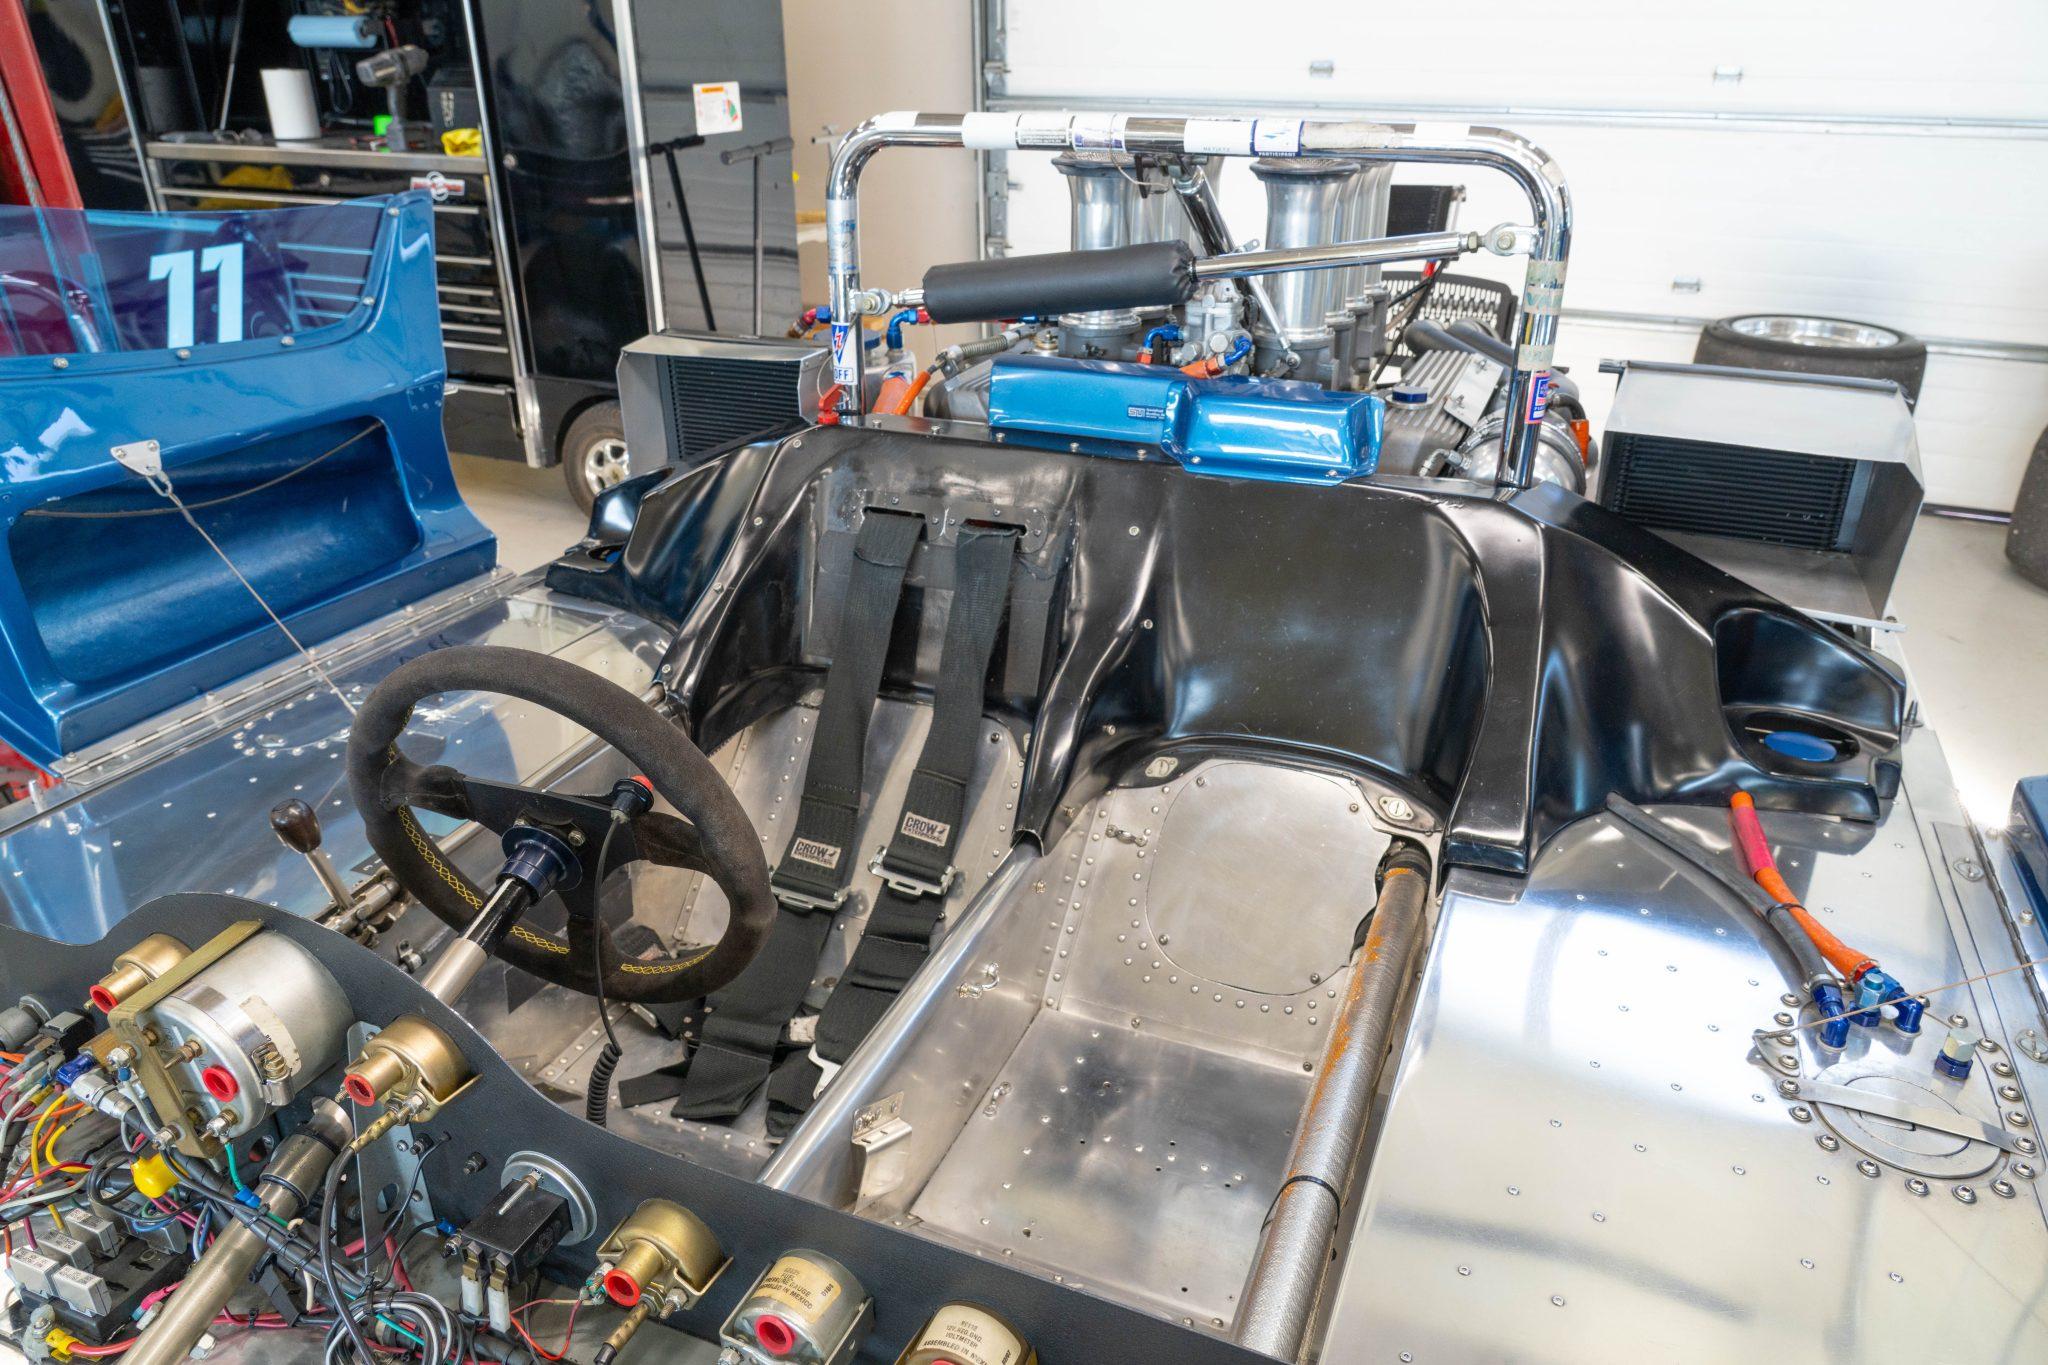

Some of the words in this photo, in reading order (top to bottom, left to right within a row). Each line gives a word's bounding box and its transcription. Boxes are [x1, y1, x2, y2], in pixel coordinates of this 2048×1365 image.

[149, 242, 243, 348] 11
[905, 817, 938, 835] CROW
[796, 841, 829, 858] CROW
[781, 1272, 796, 1282] FUEL
[782, 1286, 790, 1294] IN
[790, 1290, 813, 1310] MEXICO
[789, 1282, 812, 1298] GAUGE
[924, 1339, 960, 1351] ASSEMBLED
[961, 1346, 970, 1356] IN
[945, 1332, 978, 1349] VOLTMETER
